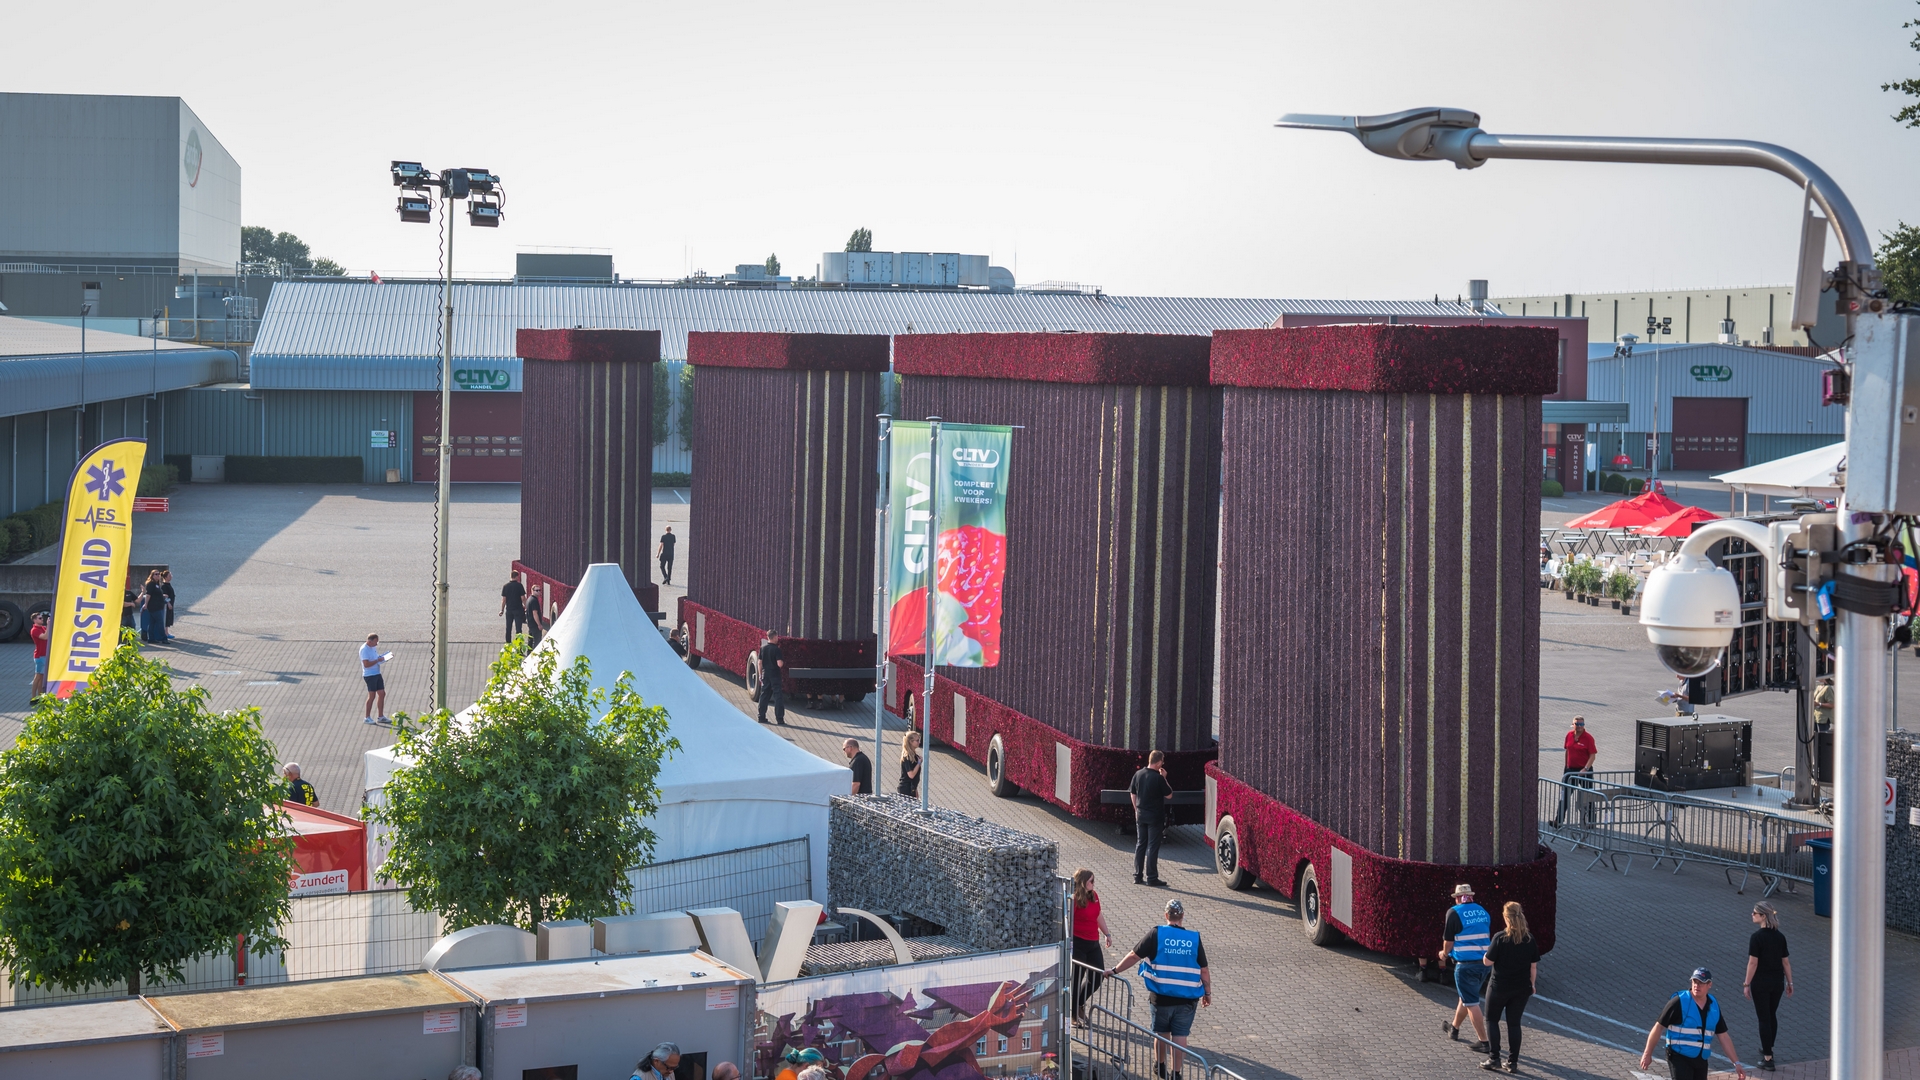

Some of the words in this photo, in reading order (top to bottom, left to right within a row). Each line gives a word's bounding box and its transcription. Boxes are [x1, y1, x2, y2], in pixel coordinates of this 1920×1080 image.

[454, 369, 499, 384] CLTV
[1690, 365, 1723, 377] CLTV
[953, 447, 991, 462] CLTV
[954, 480, 994, 489] COMPLEET
[954, 496, 993, 505] KWEKERS!
[903, 475, 933, 574] CLTV
[67, 538, 112, 673] FIRST-AID
[300, 873, 345, 888] zundert
[1463, 909, 1486, 918] corso
[1164, 938, 1193, 947] corso
